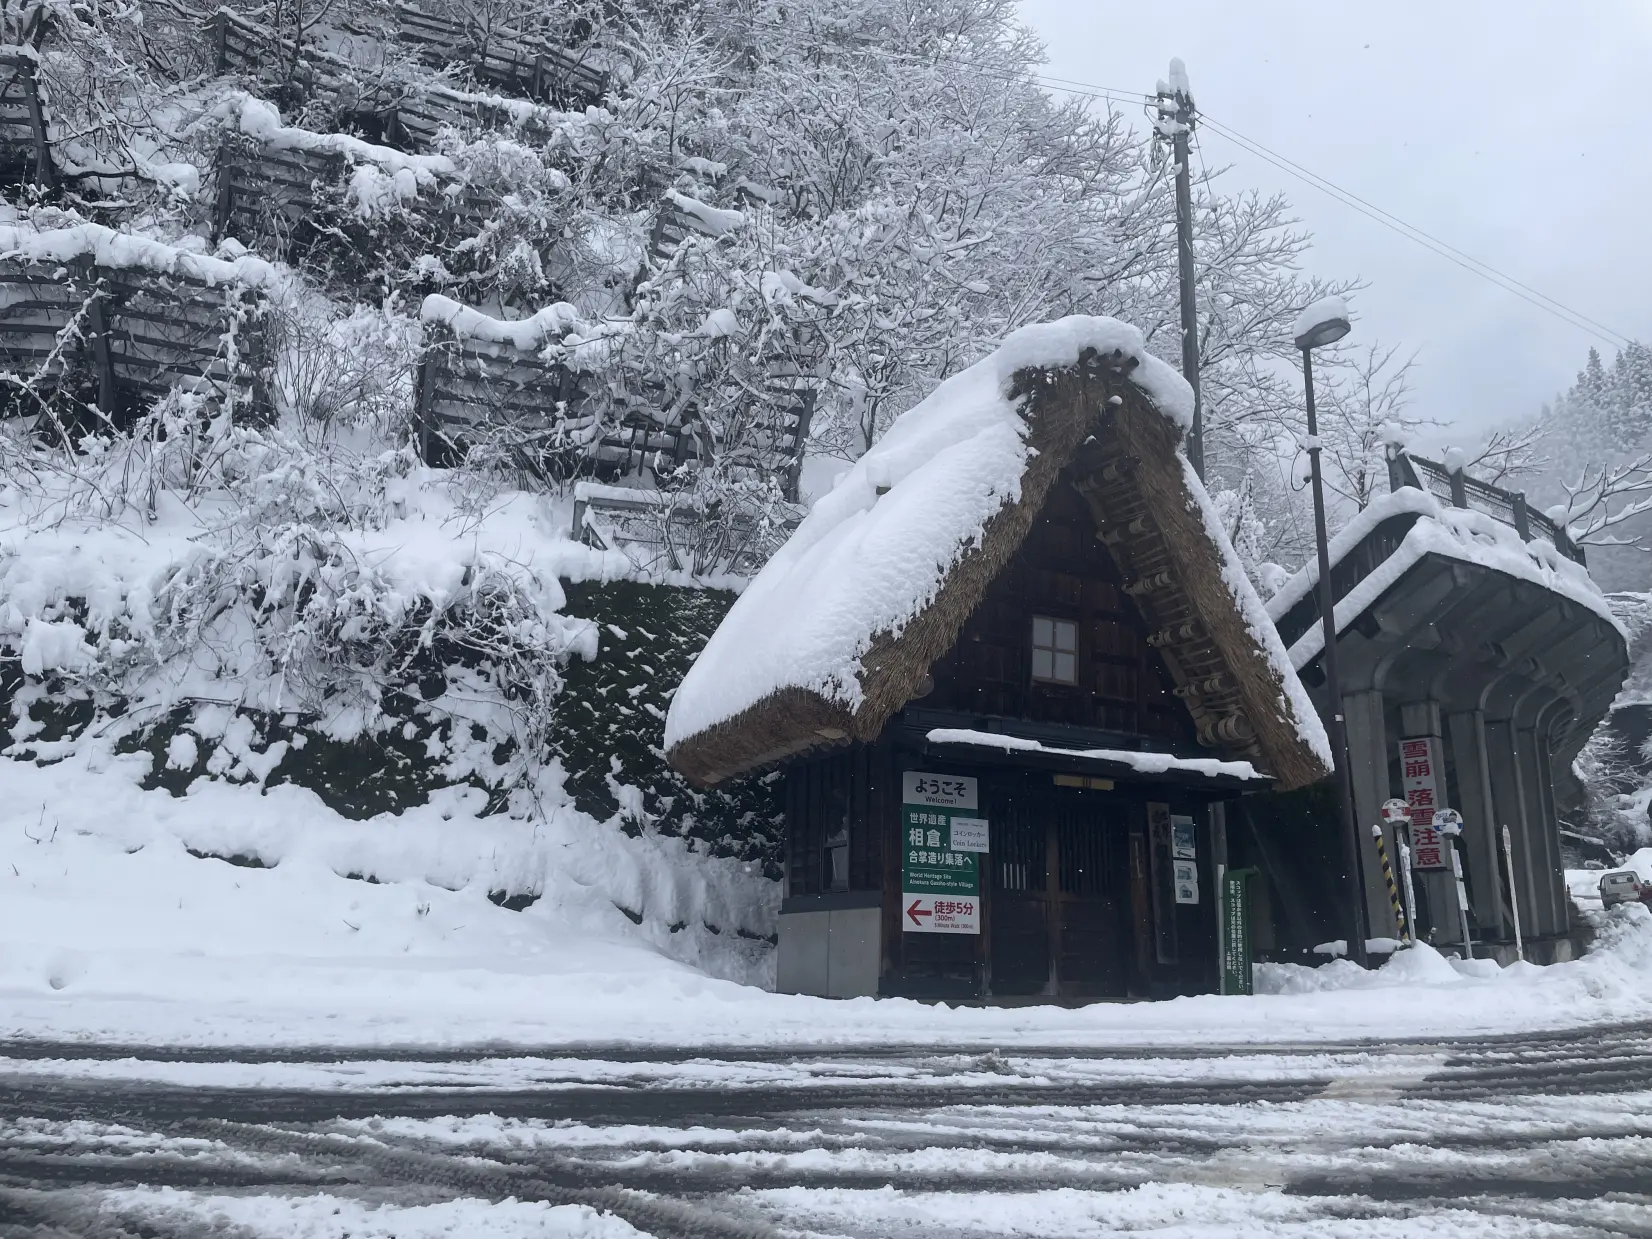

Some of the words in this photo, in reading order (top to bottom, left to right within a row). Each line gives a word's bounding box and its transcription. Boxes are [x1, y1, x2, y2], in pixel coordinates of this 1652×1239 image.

[915, 778, 967, 798] ようこそ
[925, 796, 957, 805] Welcome!
[1403, 740, 1442, 866] 雪崩・落雪注意
[909, 812, 947, 826] 世界遺産
[909, 828, 941, 848] 相倉
[953, 830, 986, 838] コインロッカー
[952, 839, 966, 847] Coin
[967, 839, 988, 848] Lockers
[909, 850, 973, 866] 合掌造り集落へ
[958, 881, 974, 889] Village
[934, 900, 974, 916] 徒歩5分
[935, 914, 955, 922] (300m)
